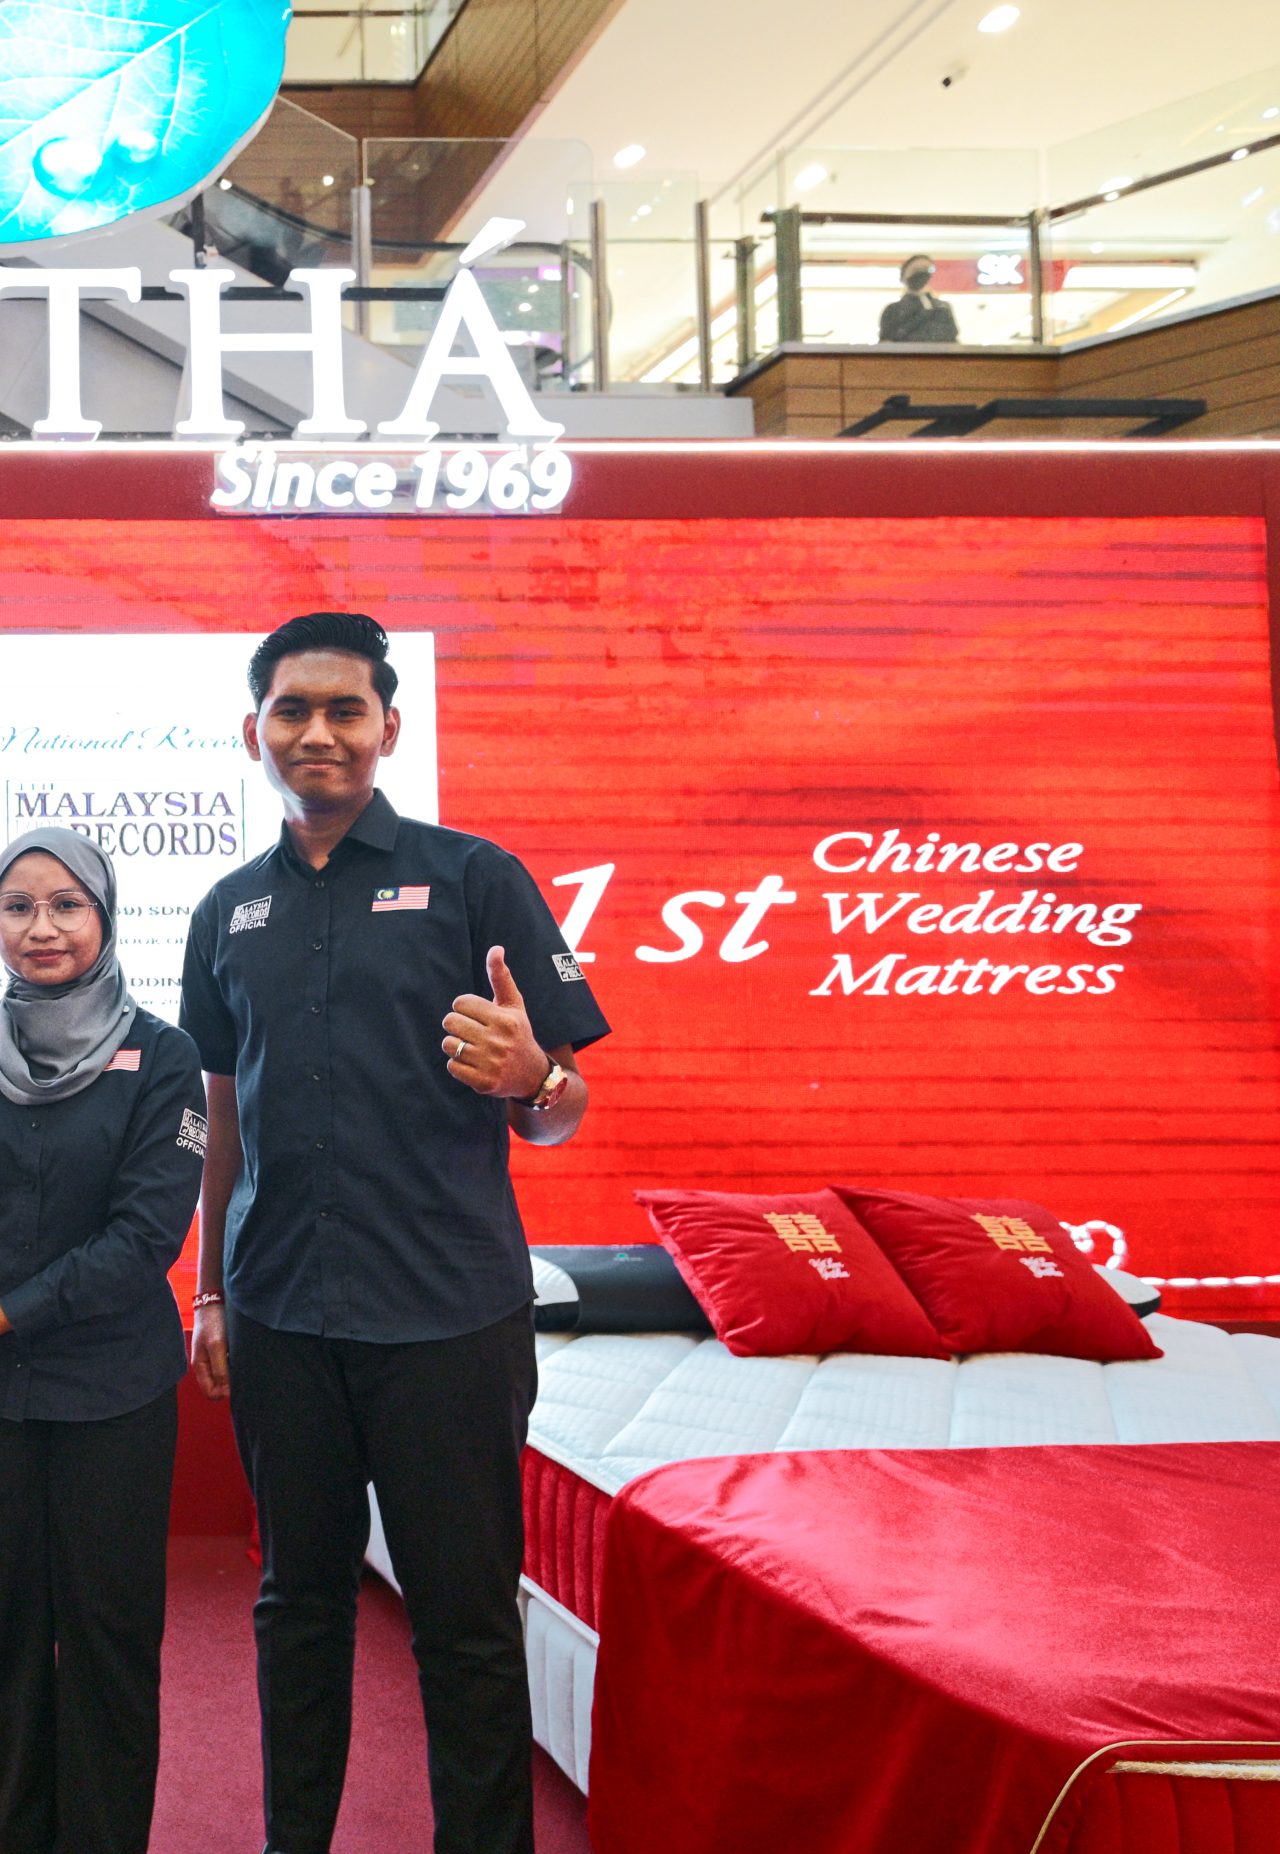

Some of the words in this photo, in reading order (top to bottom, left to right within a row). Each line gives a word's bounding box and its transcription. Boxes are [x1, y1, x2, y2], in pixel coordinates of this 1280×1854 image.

[210, 447, 397, 508] Since
[414, 449, 572, 509] 1969
[138, 725, 245, 750] Recor
[15, 791, 236, 818] MALAYSIA
[813, 829, 1084, 873] Chinese
[229, 919, 266, 934] OFFICIAL
[551, 862, 797, 963] 1st
[821, 889, 1143, 946] Wedding
[130, 977, 182, 987] DDIN
[809, 953, 1125, 996] Mattress
